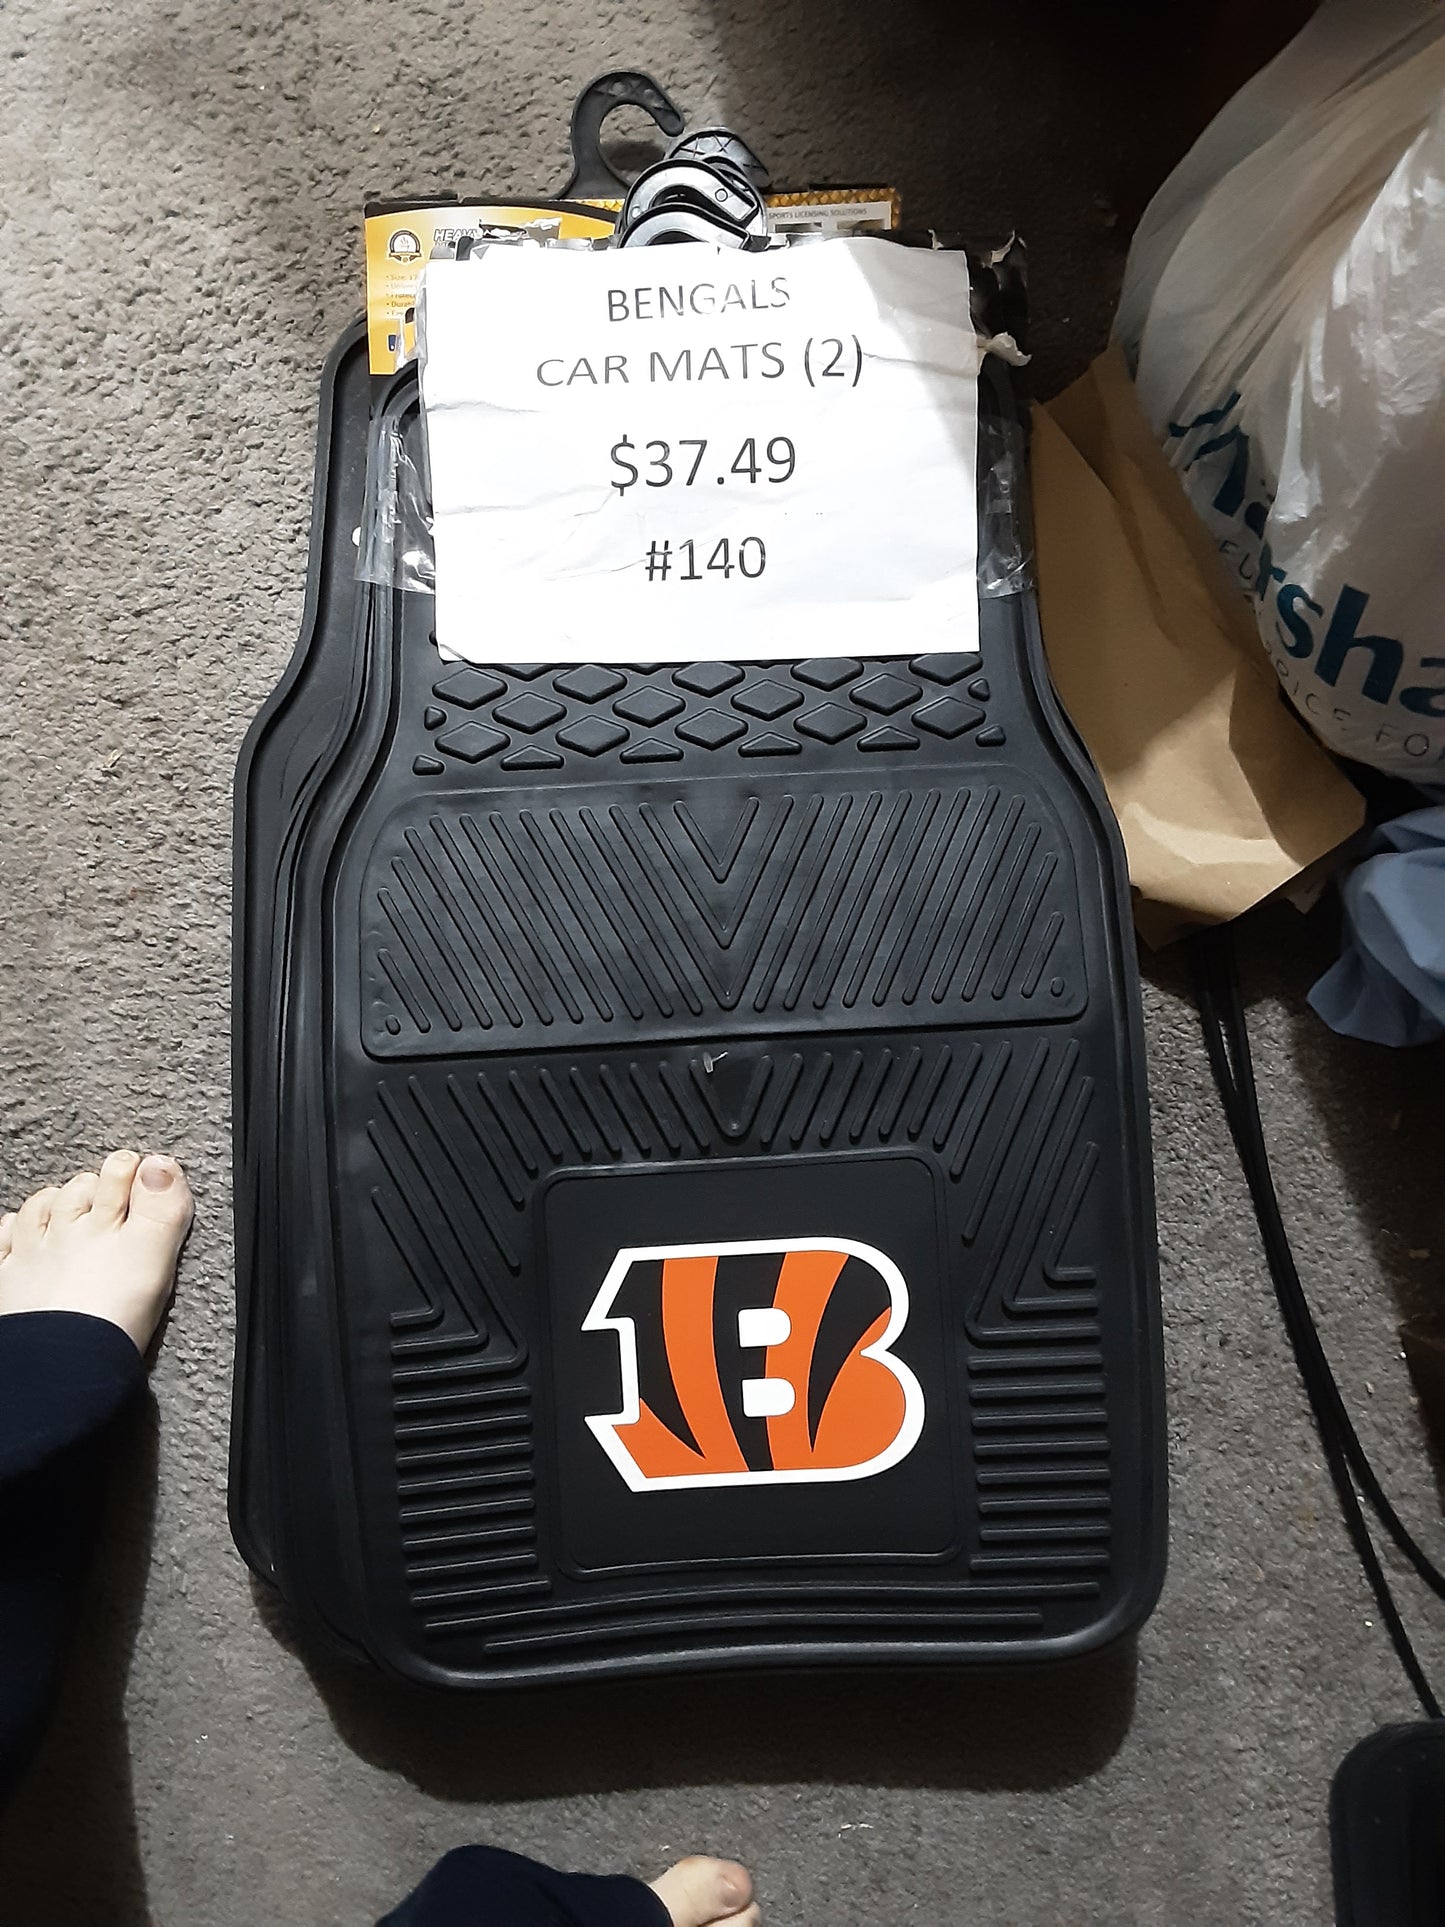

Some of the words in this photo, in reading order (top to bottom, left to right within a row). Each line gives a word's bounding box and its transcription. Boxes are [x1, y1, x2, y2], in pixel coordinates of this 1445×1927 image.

[607, 277, 790, 322] BENGALS
[536, 355, 629, 387] CAR
[650, 342, 785, 382] MATS
[804, 334, 862, 388] (2)
[610, 433, 796, 497] $37.49
[644, 536, 767, 582] #140
